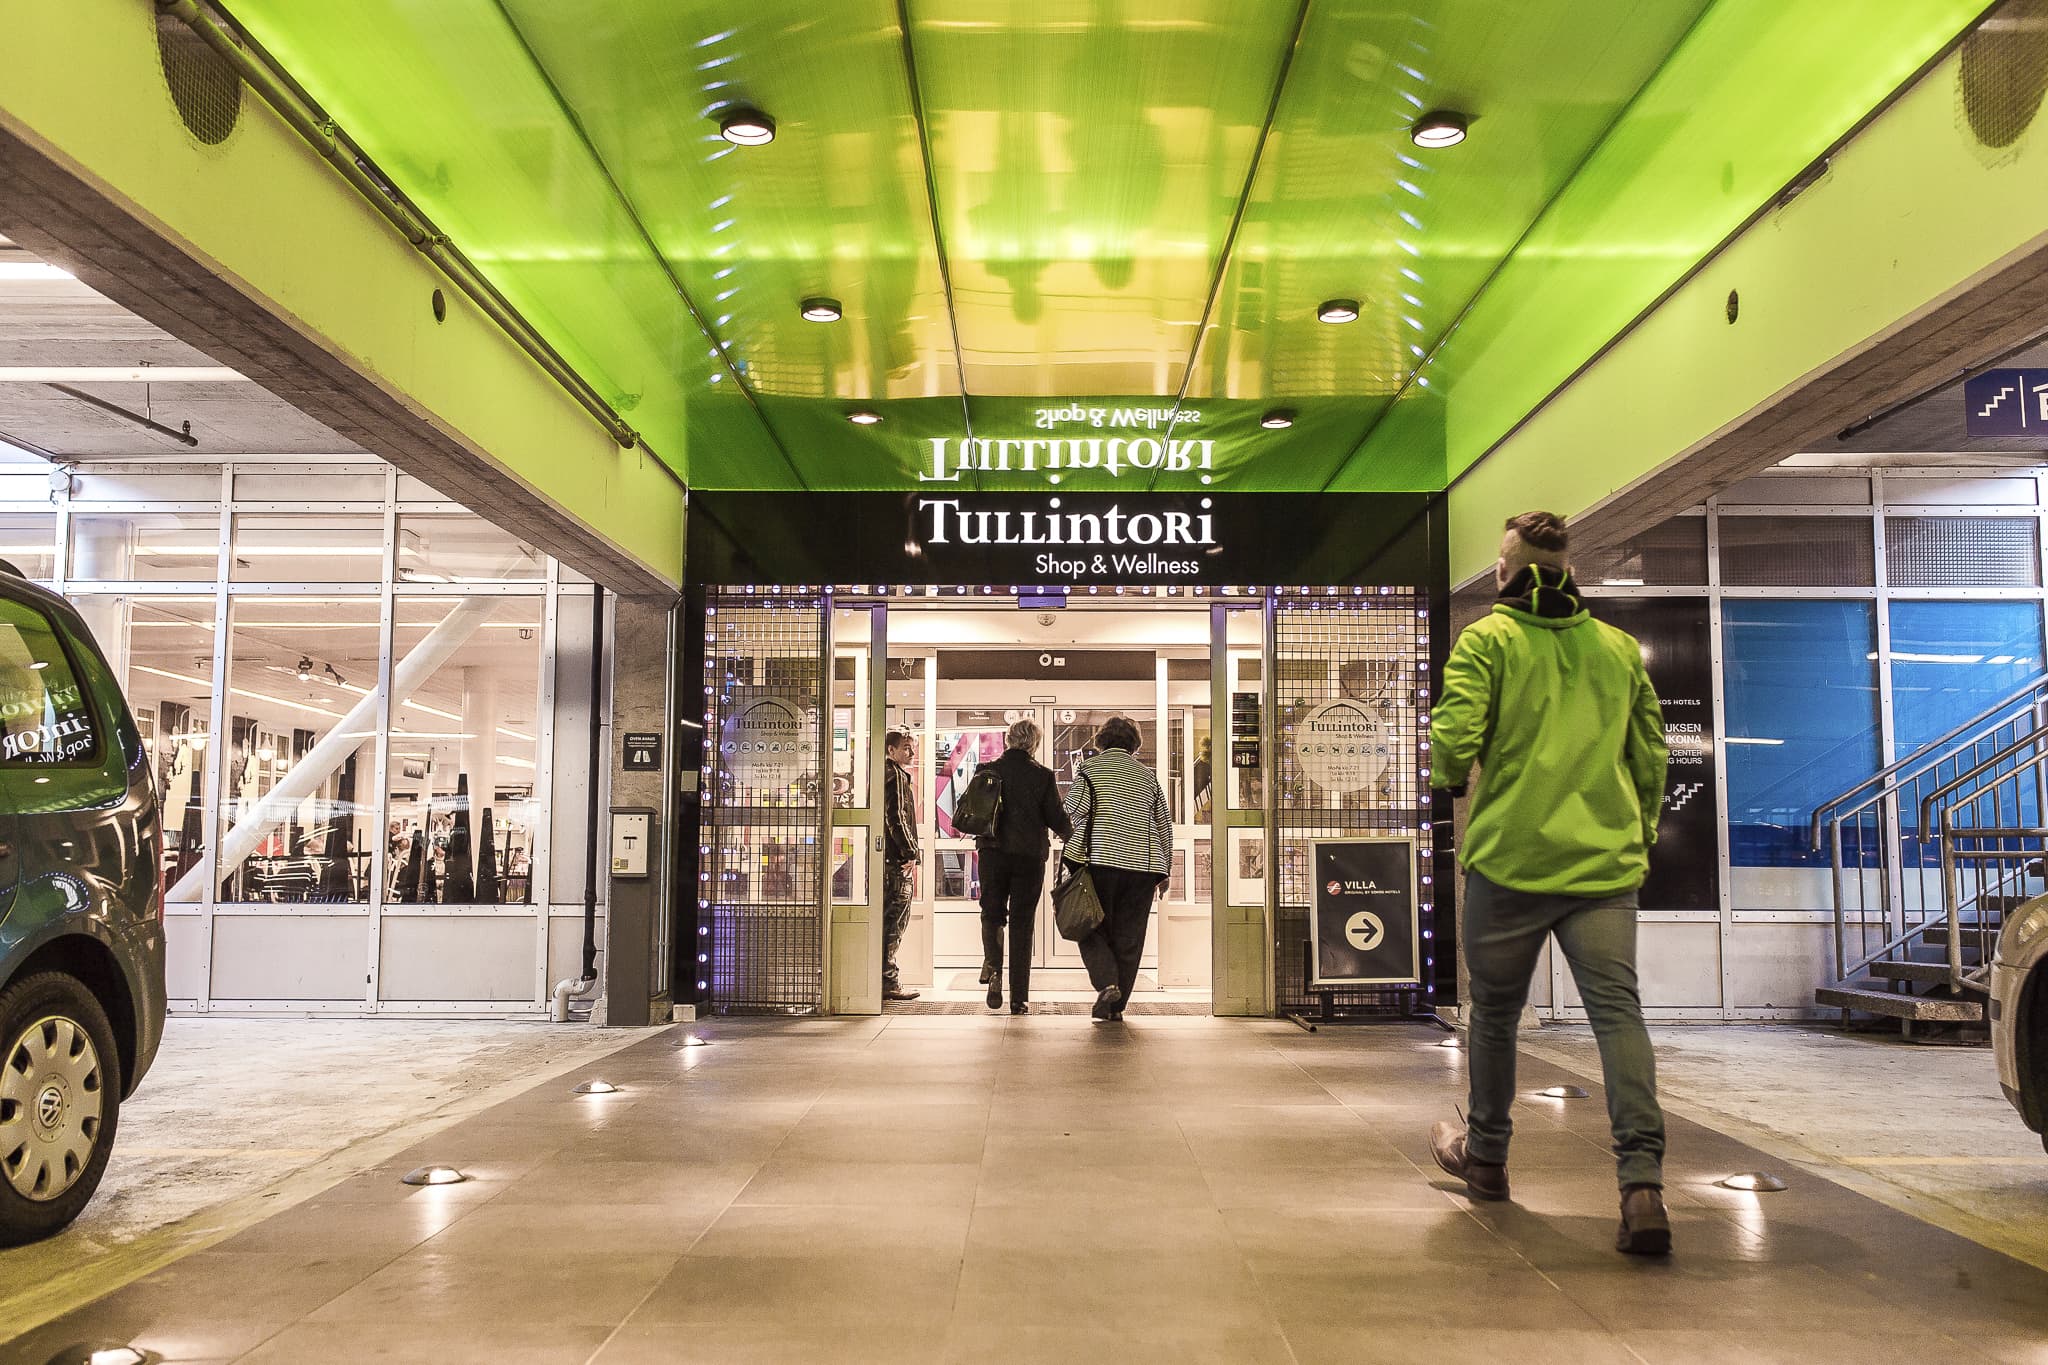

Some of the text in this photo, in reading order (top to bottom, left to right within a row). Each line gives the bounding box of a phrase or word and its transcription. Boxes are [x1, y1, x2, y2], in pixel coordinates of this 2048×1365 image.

[1035, 553, 1199, 579] Shop & Wellness
[1664, 735, 1702, 744] IKOINA
[1672, 749, 1702, 757] CENTER
[1344, 880, 1377, 889] VILLA
